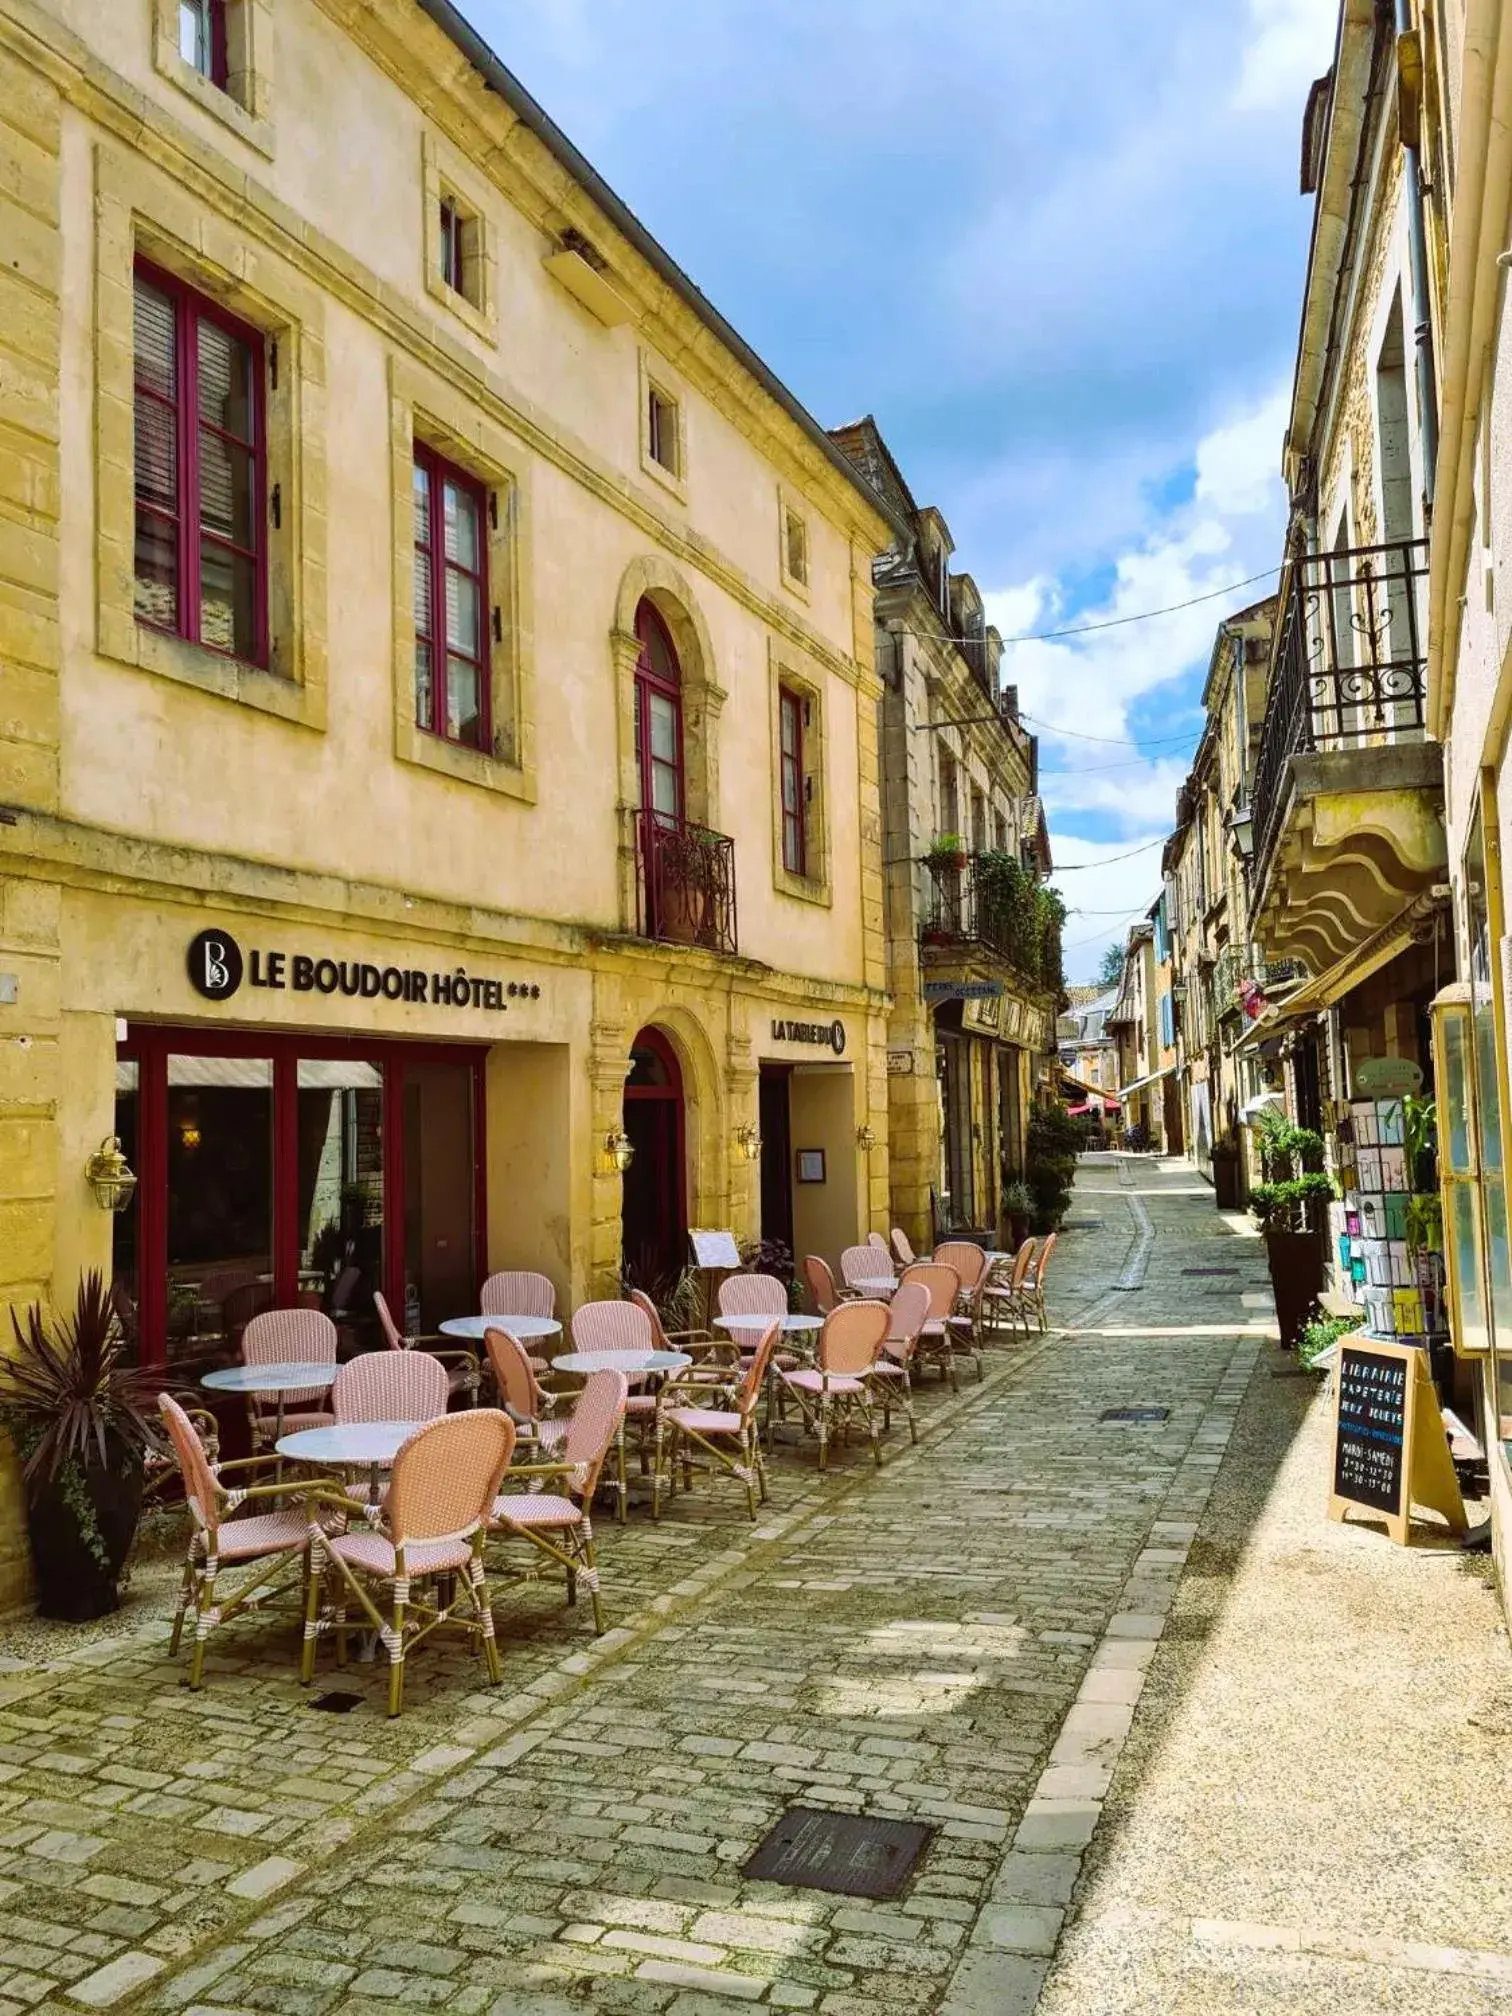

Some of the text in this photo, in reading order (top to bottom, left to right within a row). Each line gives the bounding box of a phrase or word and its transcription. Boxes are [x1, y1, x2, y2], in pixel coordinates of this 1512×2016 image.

[249, 950, 287, 989] LE
[292, 955, 428, 1004] BOUDOIR
[771, 1020, 786, 1040] LA
[786, 1021, 816, 1044] TABLE
